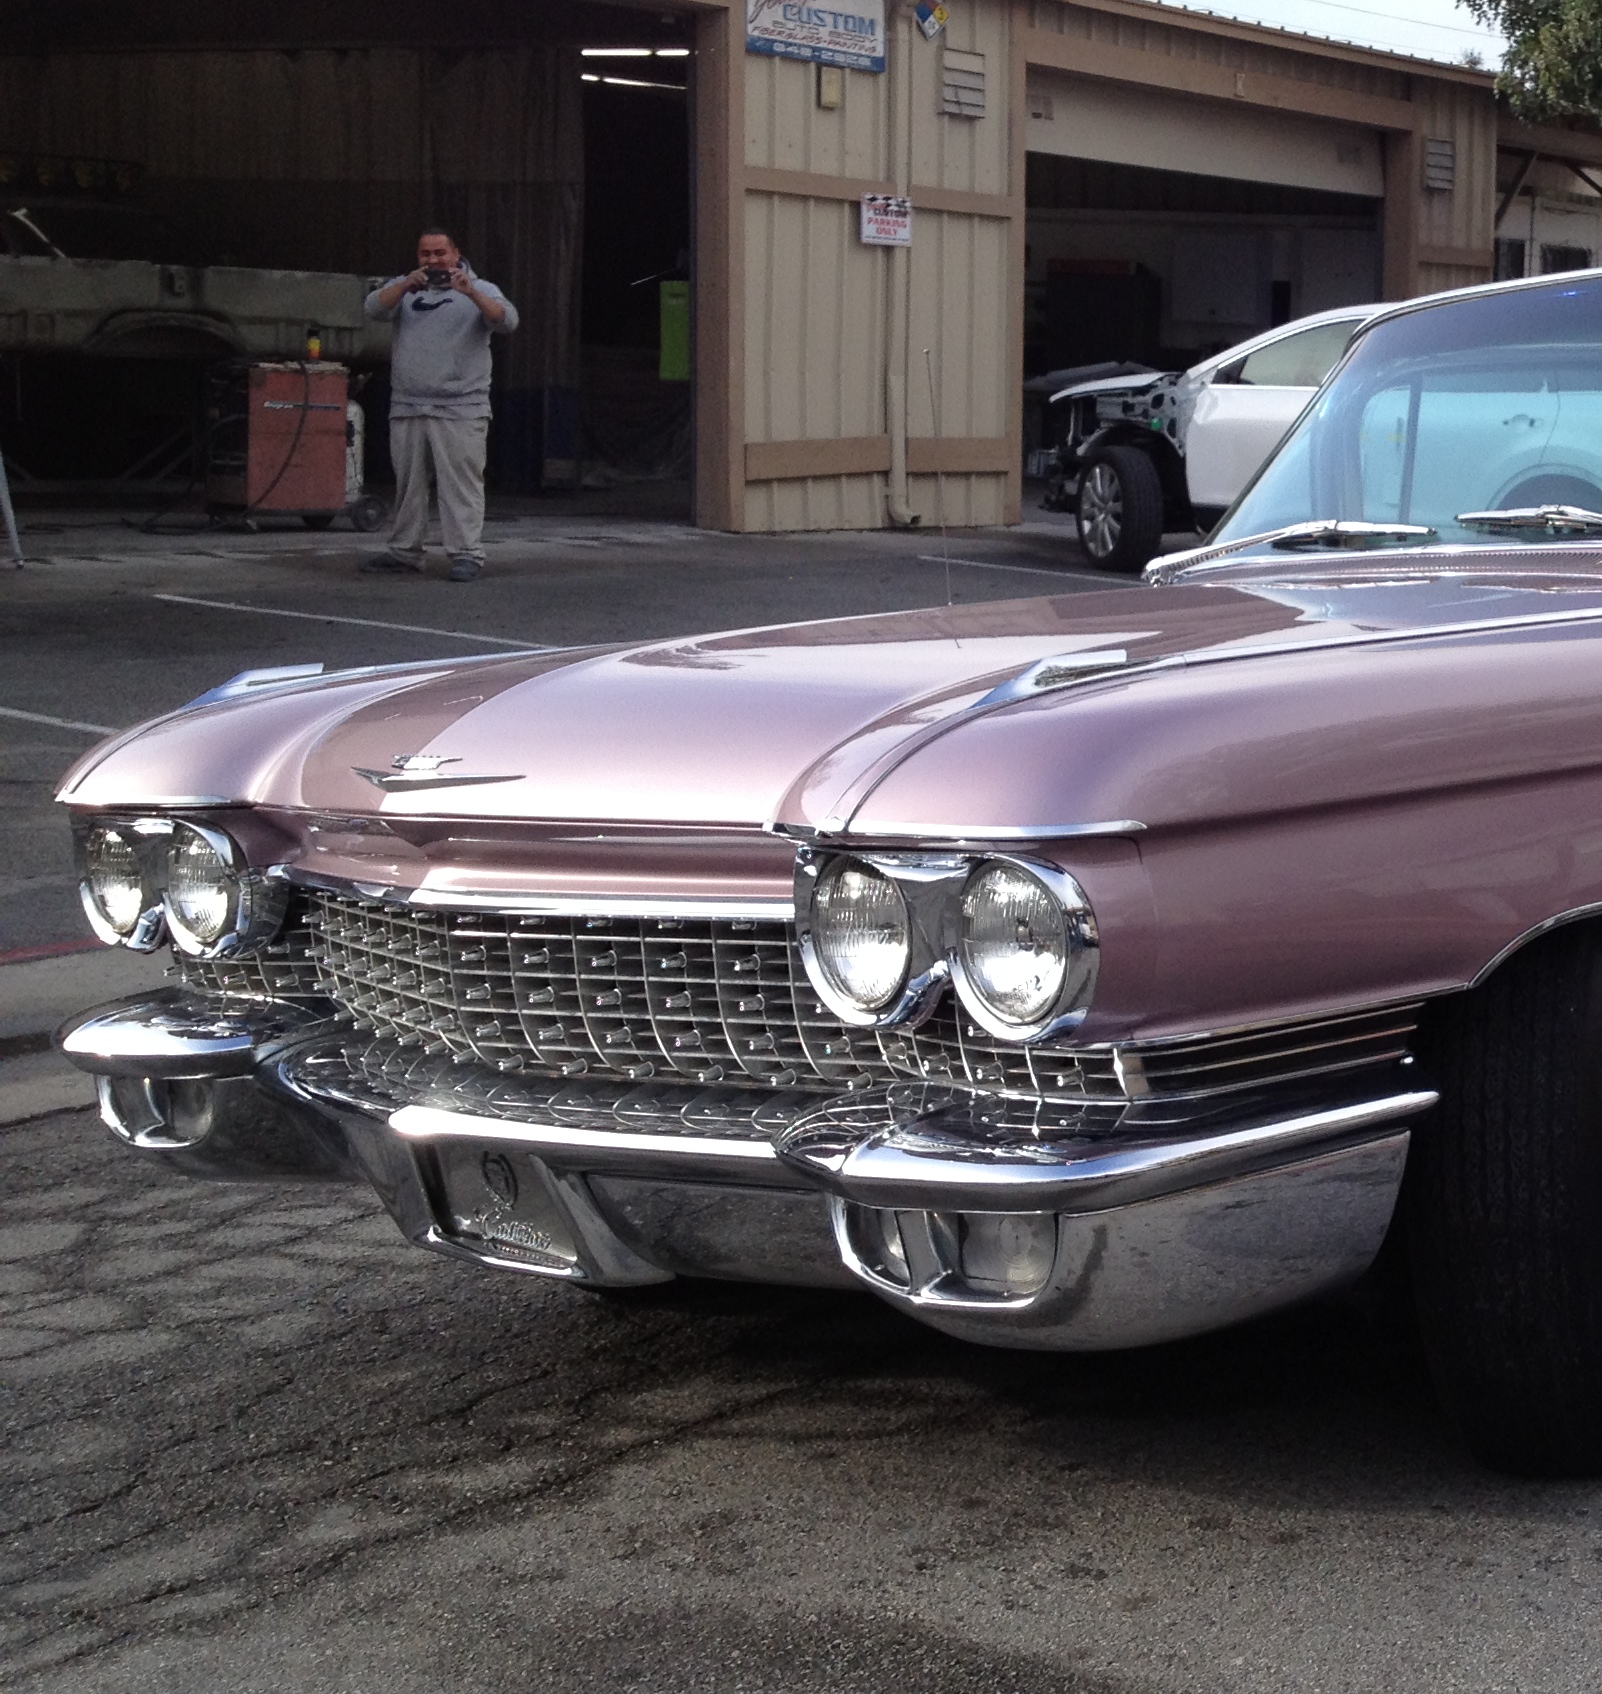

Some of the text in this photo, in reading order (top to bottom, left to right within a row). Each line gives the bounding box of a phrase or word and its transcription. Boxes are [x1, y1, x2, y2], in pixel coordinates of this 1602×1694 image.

[783, 4, 875, 36] CUSTOM
[772, 20, 878, 43] AUTO BODY
[867, 217, 907, 228] PARKING
[876, 226, 897, 236] ONLY
